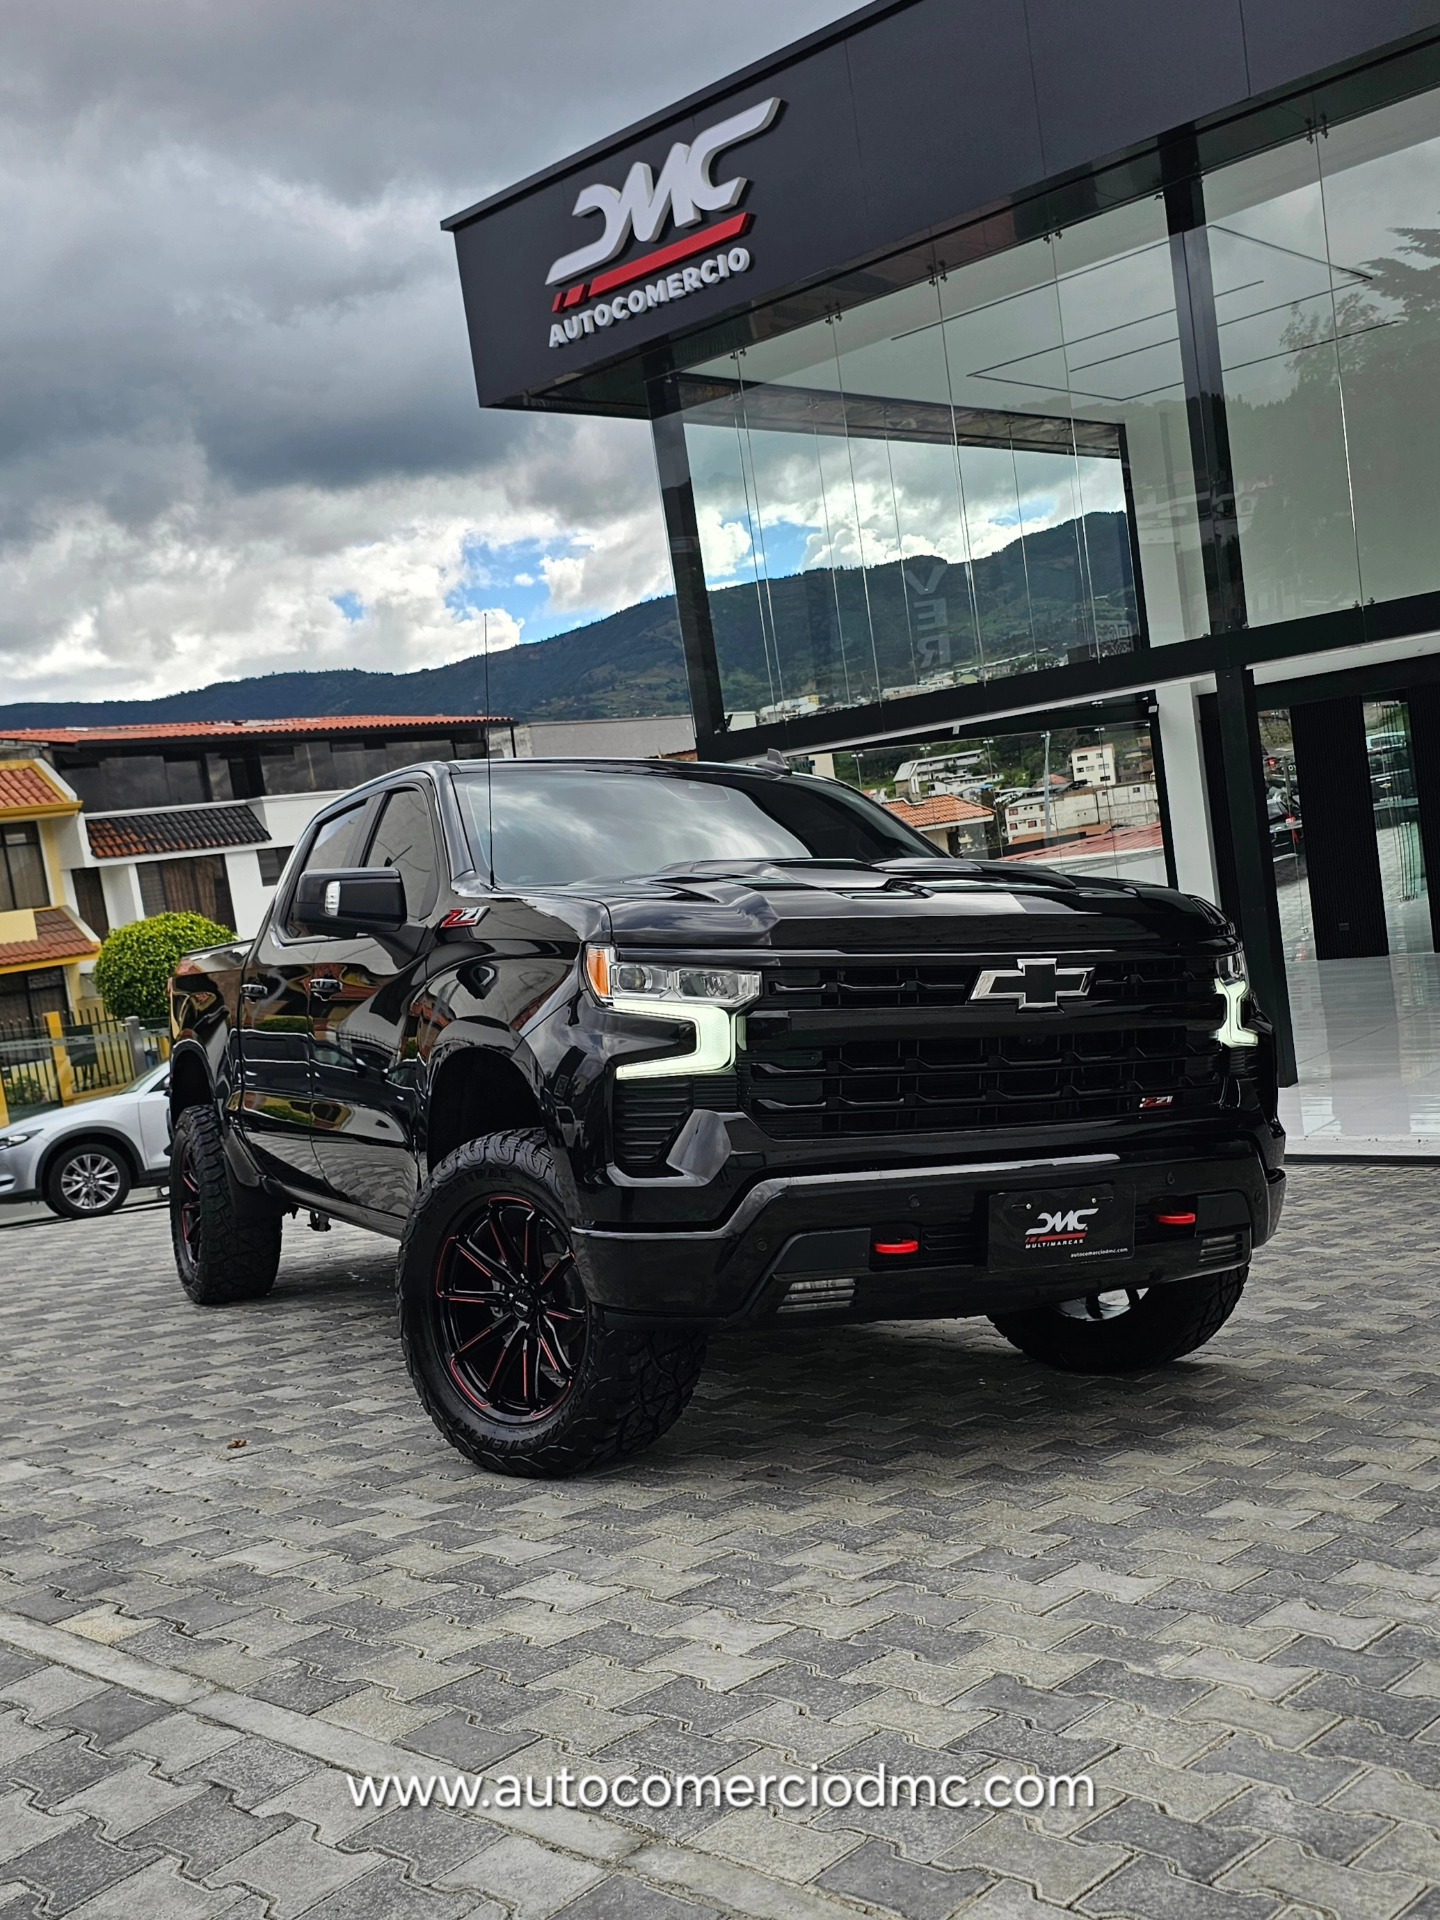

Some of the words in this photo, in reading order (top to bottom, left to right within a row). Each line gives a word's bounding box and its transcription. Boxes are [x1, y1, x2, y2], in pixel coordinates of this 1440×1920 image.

[545, 97, 781, 285] DMC
[549, 247, 750, 347] AUTOCOMERCIO
[1025, 1208, 1099, 1235] DMC
[1025, 1239, 1084, 1249] MULTIMARCAS
[1070, 1247, 1128, 1258] autocomerciodmc.com
